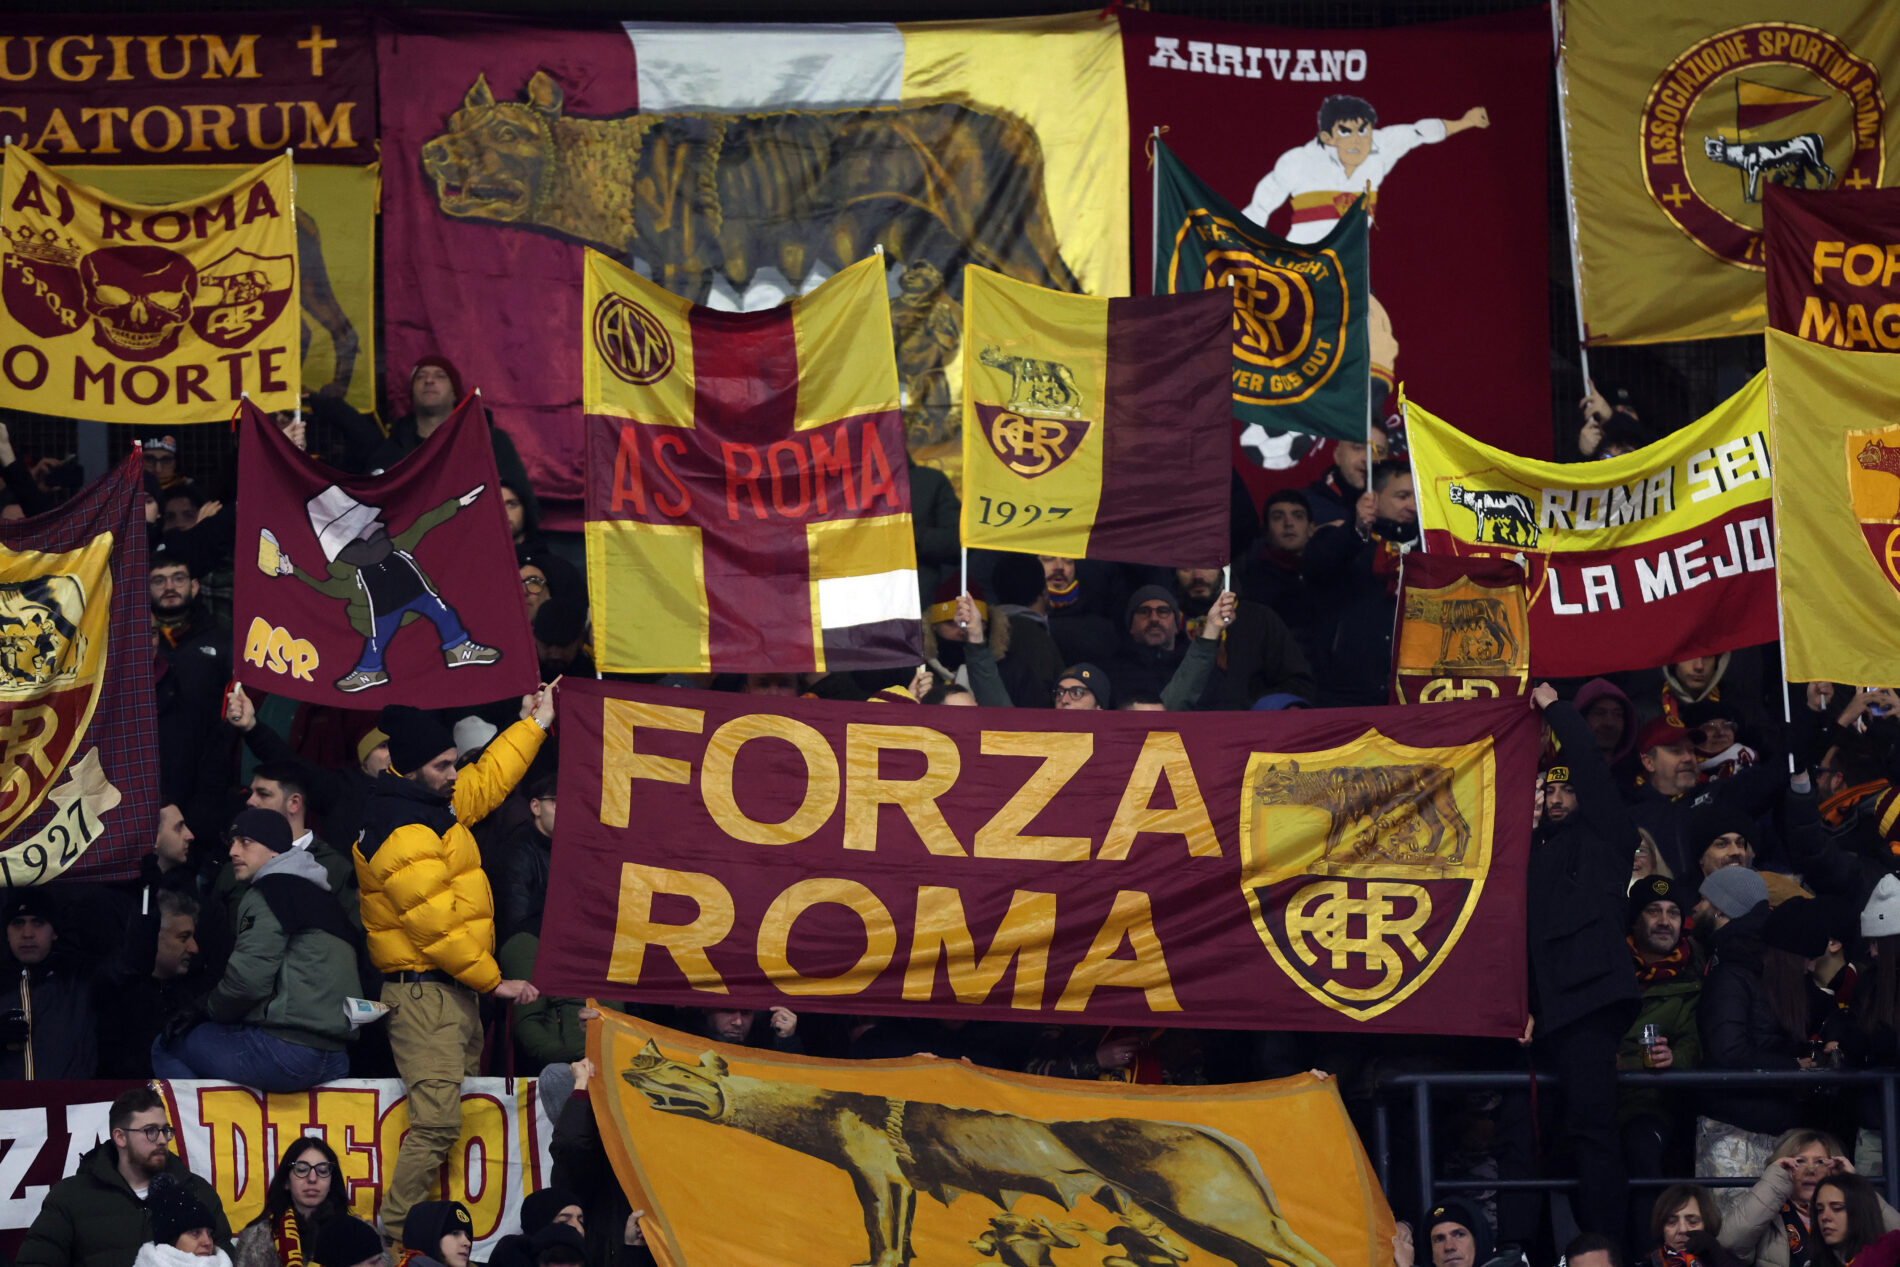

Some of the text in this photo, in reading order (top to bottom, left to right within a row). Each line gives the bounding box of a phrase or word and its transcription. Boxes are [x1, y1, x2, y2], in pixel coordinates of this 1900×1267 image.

[0, 34, 263, 82] UGIUM
[1149, 36, 1367, 82] ARRIVANO
[1651, 30, 1881, 165] ASSOCIAZIONE SPORTIVA ROMA
[100, 181, 280, 243] ROMA
[21, 266, 78, 329] SPQR
[1798, 296, 1900, 349] MAG
[3, 344, 288, 405] O MORTE
[1301, 337, 1332, 377] OUT
[610, 421, 900, 521] AS ROMA
[1539, 430, 1772, 530] ROMA SEI
[1547, 516, 1776, 615] LA MEJO
[244, 616, 320, 682] ASR
[600, 697, 1223, 862] FORZA
[0, 797, 93, 888] 1927
[606, 861, 1185, 1013] ROMA
